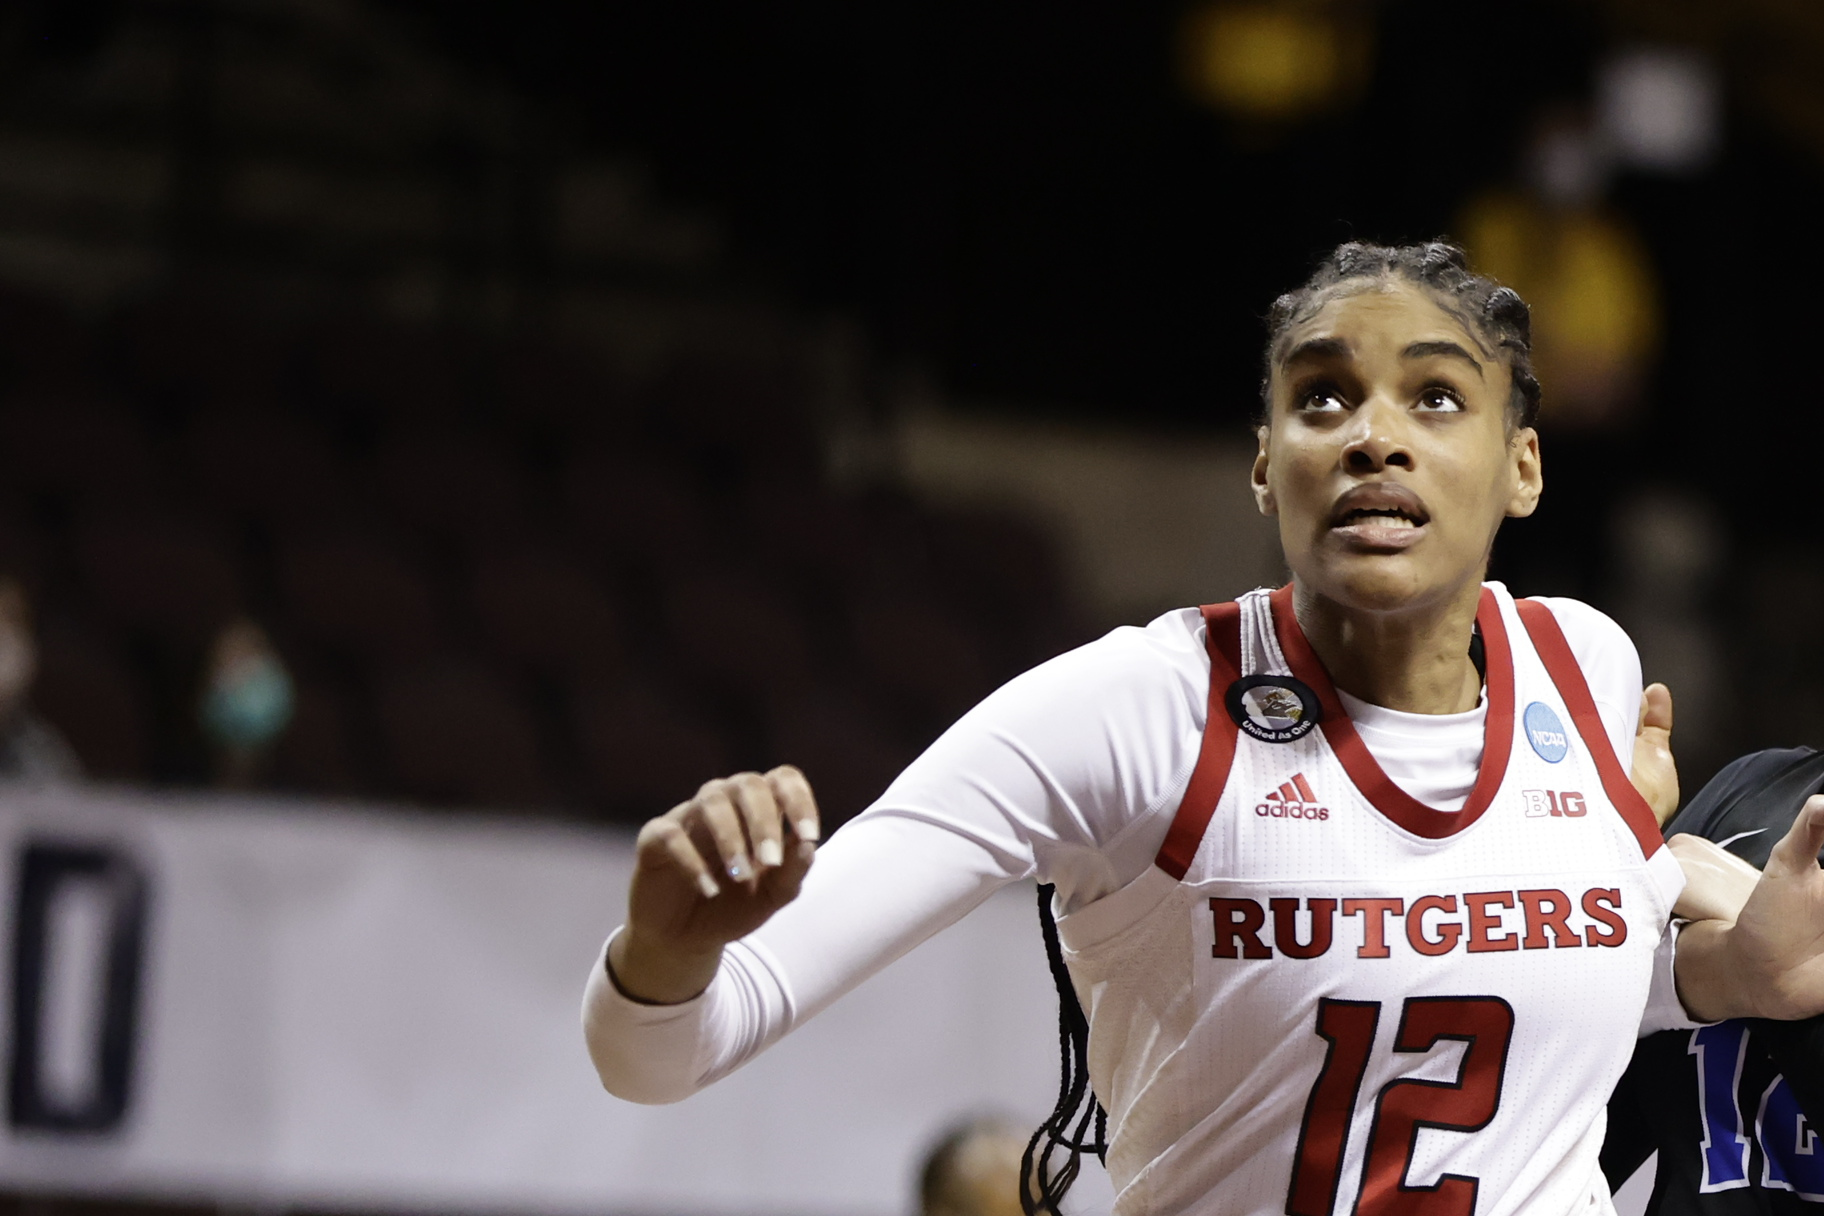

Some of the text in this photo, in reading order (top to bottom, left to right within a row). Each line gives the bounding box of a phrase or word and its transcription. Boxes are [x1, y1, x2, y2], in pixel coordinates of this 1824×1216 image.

[1241, 719, 1312, 741] United As One
[1532, 729, 1568, 748] NCAA
[1255, 800, 1329, 821] adidas
[1208, 887, 1629, 960] RUTGERS
